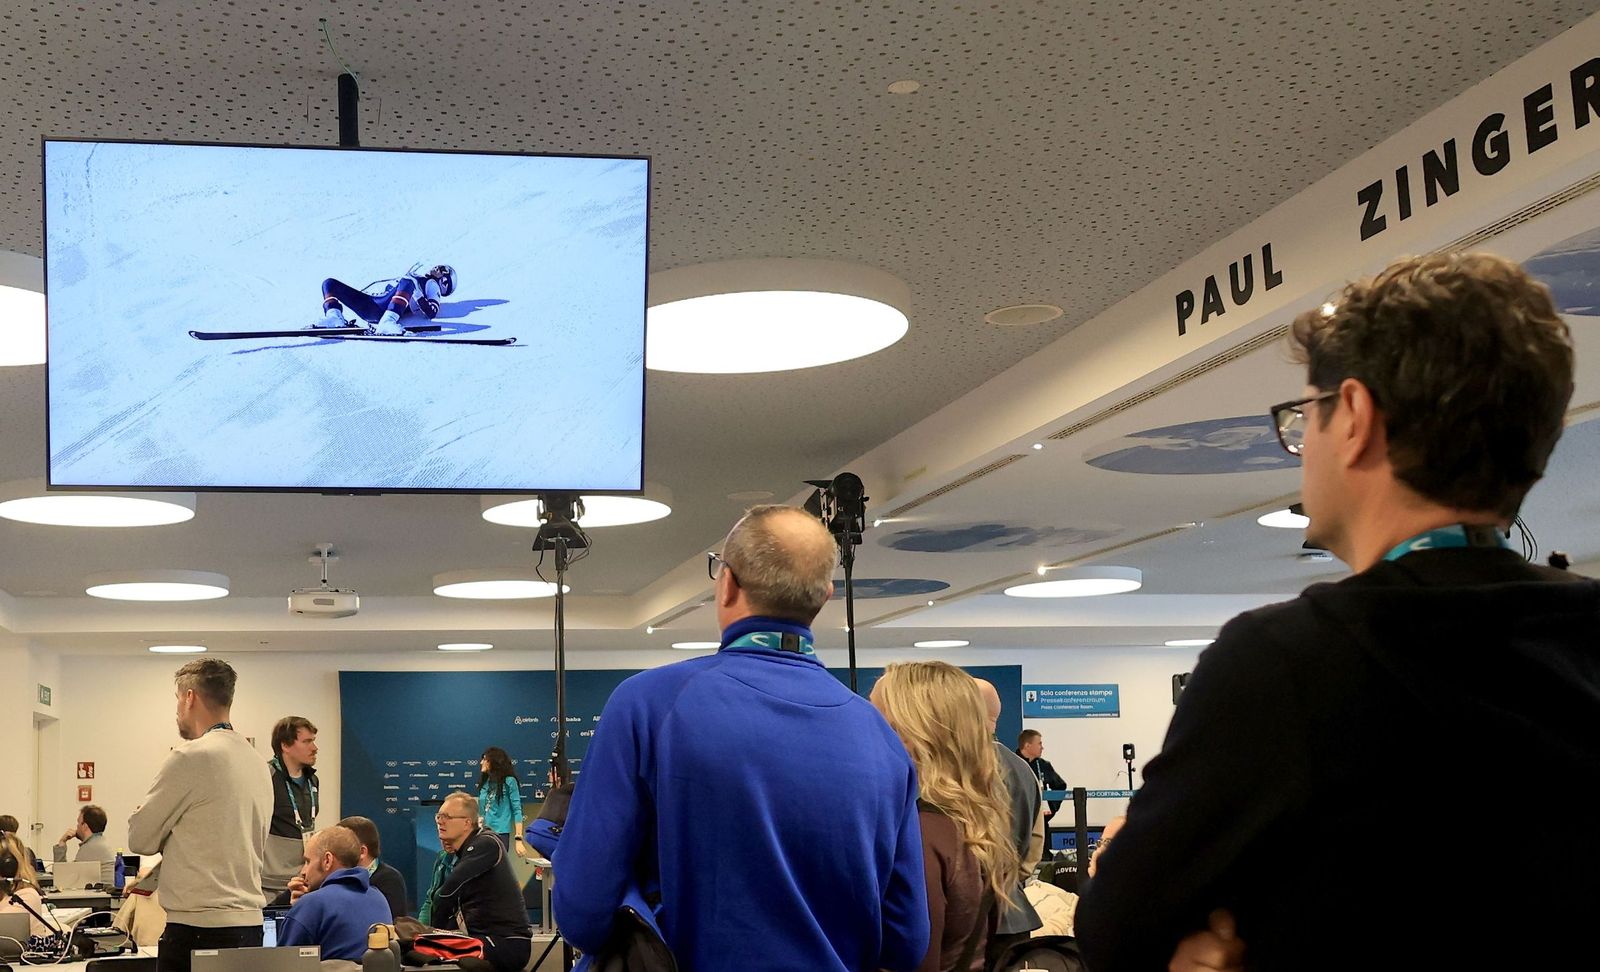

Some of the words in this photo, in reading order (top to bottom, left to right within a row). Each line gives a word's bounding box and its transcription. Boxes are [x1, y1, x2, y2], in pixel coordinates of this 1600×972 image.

[1175, 243, 1282, 336] PAUL
[1357, 57, 1600, 242] ZINGER
[1056, 866, 1077, 875] LOVEN
